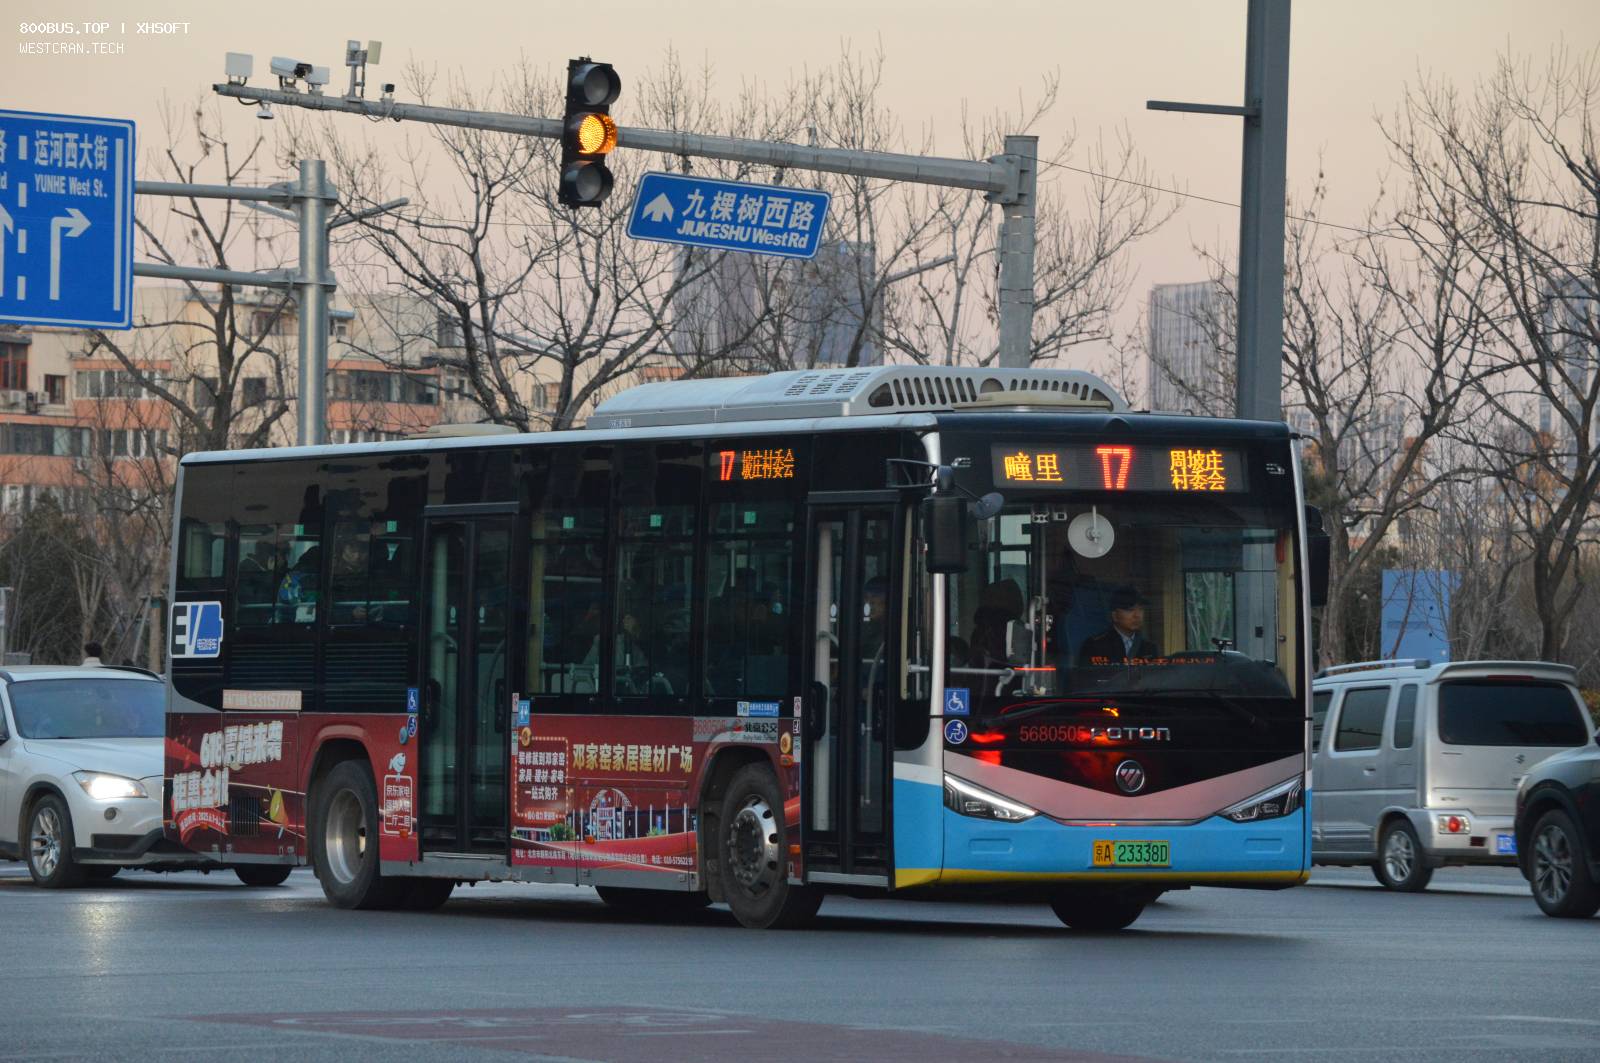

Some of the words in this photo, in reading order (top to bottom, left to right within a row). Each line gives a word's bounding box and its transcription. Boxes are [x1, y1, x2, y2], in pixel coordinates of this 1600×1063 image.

[34, 129, 108, 171] 运河西大街
[34, 173, 66, 194] YUNHE
[68, 176, 90, 196] West
[93, 178, 108, 198] St.
[682, 188, 815, 232] 九棵树西路
[676, 219, 751, 243] JIUKESHU
[752, 227, 789, 247] West
[788, 232, 809, 249] Rd
[719, 450, 736, 480] 17
[1096, 447, 1132, 489] 17
[1170, 450, 1223, 471] 周坡庄
[1171, 470, 1225, 490] 村委会
[1019, 726, 1086, 742] 5680505
[518, 752, 565, 767] 装修就到邓家窑
[572, 743, 693, 773] 邓家窑家居建材广场
[525, 786, 559, 800] 一站式购齐
[1095, 845, 1112, 862] 京A
[1118, 844, 1168, 862] 23338D
